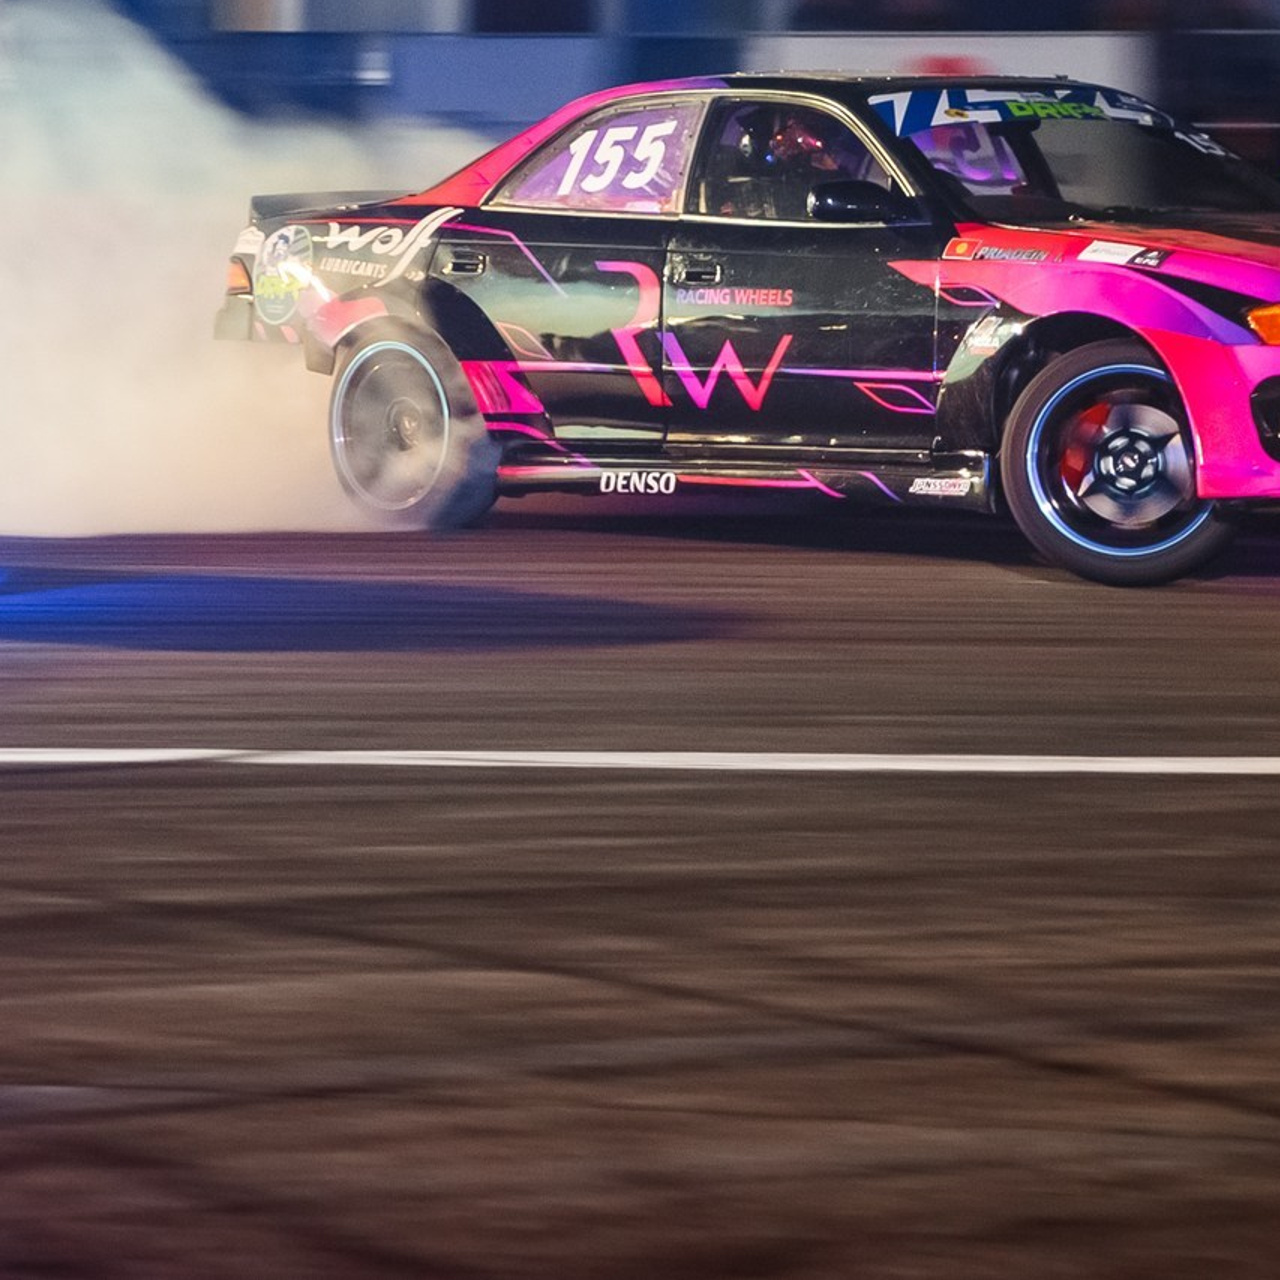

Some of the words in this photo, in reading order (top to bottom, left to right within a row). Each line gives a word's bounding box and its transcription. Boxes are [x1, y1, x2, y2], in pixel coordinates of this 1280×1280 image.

[556, 120, 678, 196] 155
[319, 256, 388, 280] LUBRICANTS
[676, 288, 730, 306] RACING
[734, 288, 793, 307] WHEELS
[599, 471, 677, 495] DENSO
